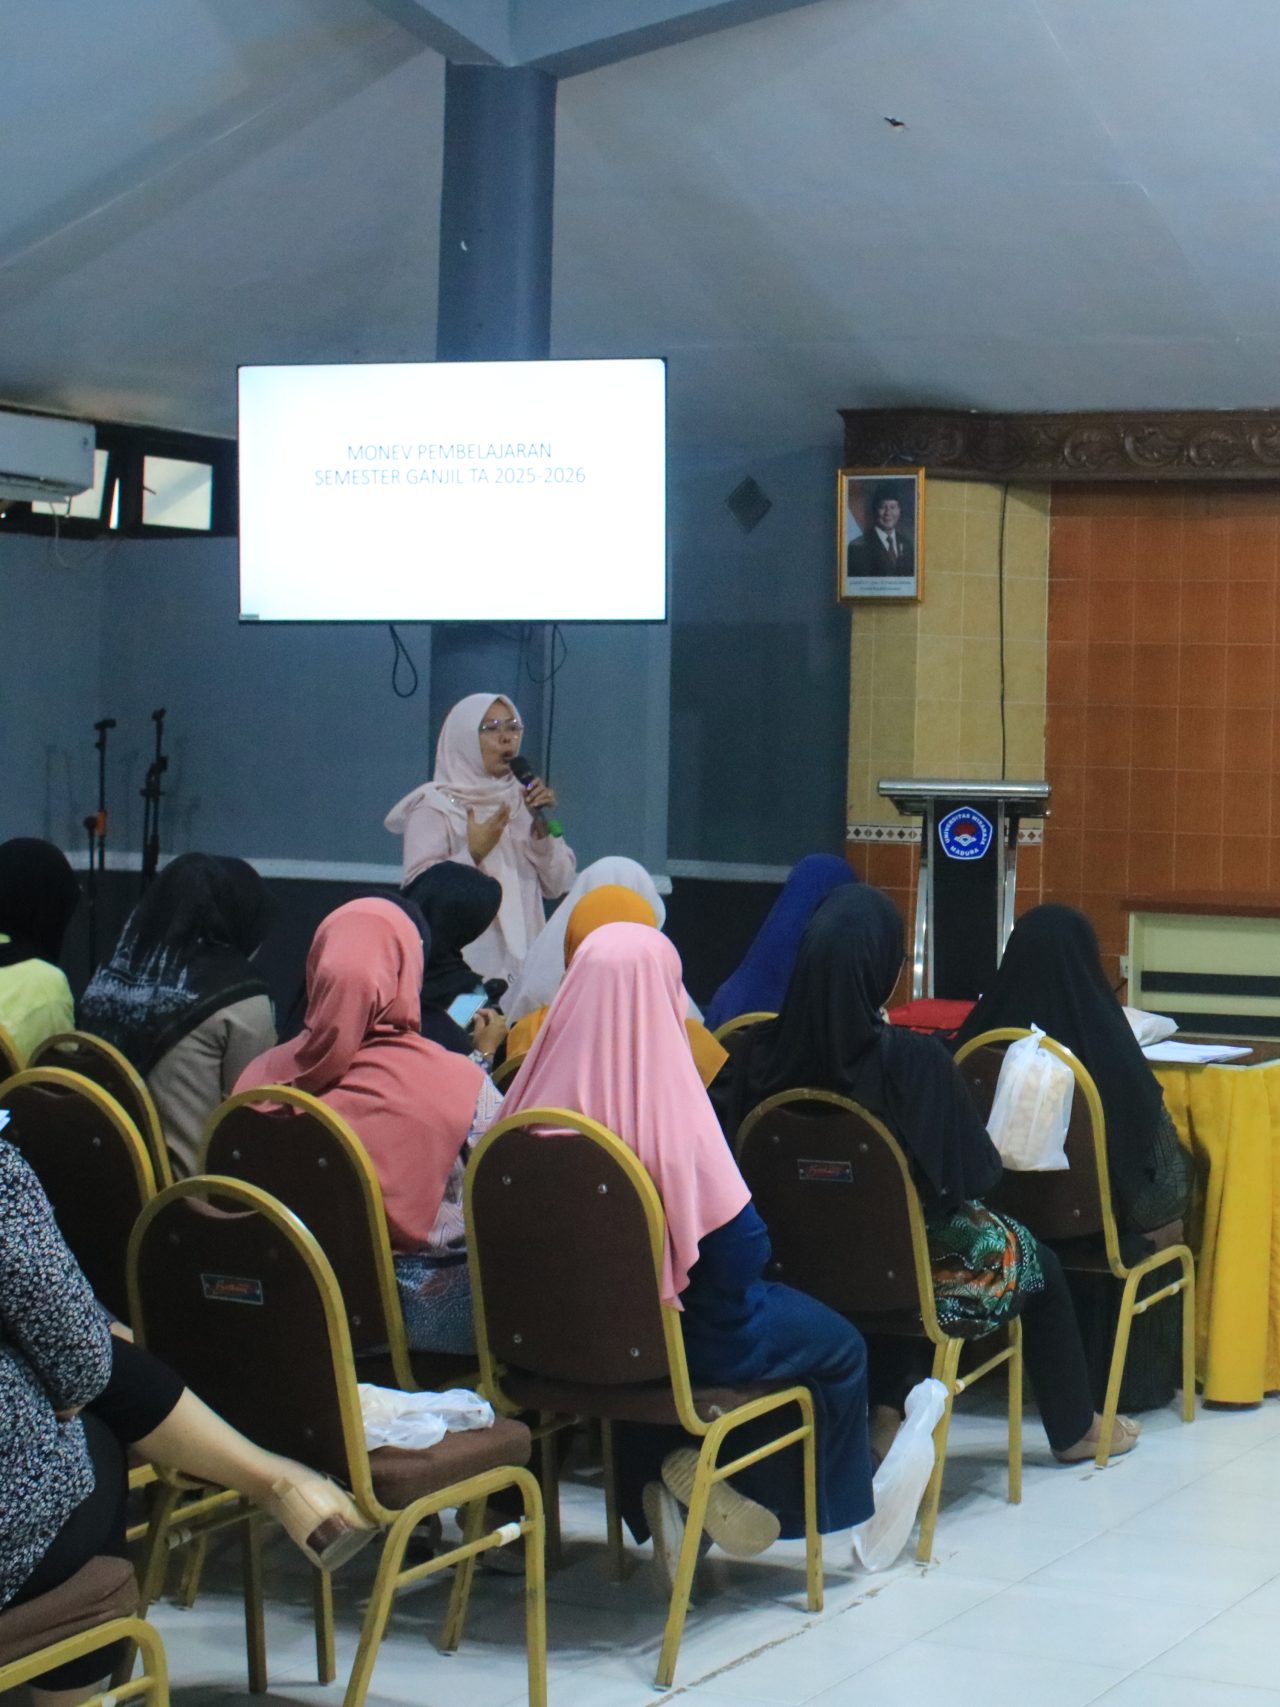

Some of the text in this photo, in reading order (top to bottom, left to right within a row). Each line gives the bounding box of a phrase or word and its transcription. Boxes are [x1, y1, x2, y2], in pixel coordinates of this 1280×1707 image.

[347, 442, 552, 461] MONEV PEMBELAJARAN
[314, 466, 587, 485] SEMESTER GANJIL TA 2025-2026
[950, 845, 980, 856] MADURA
